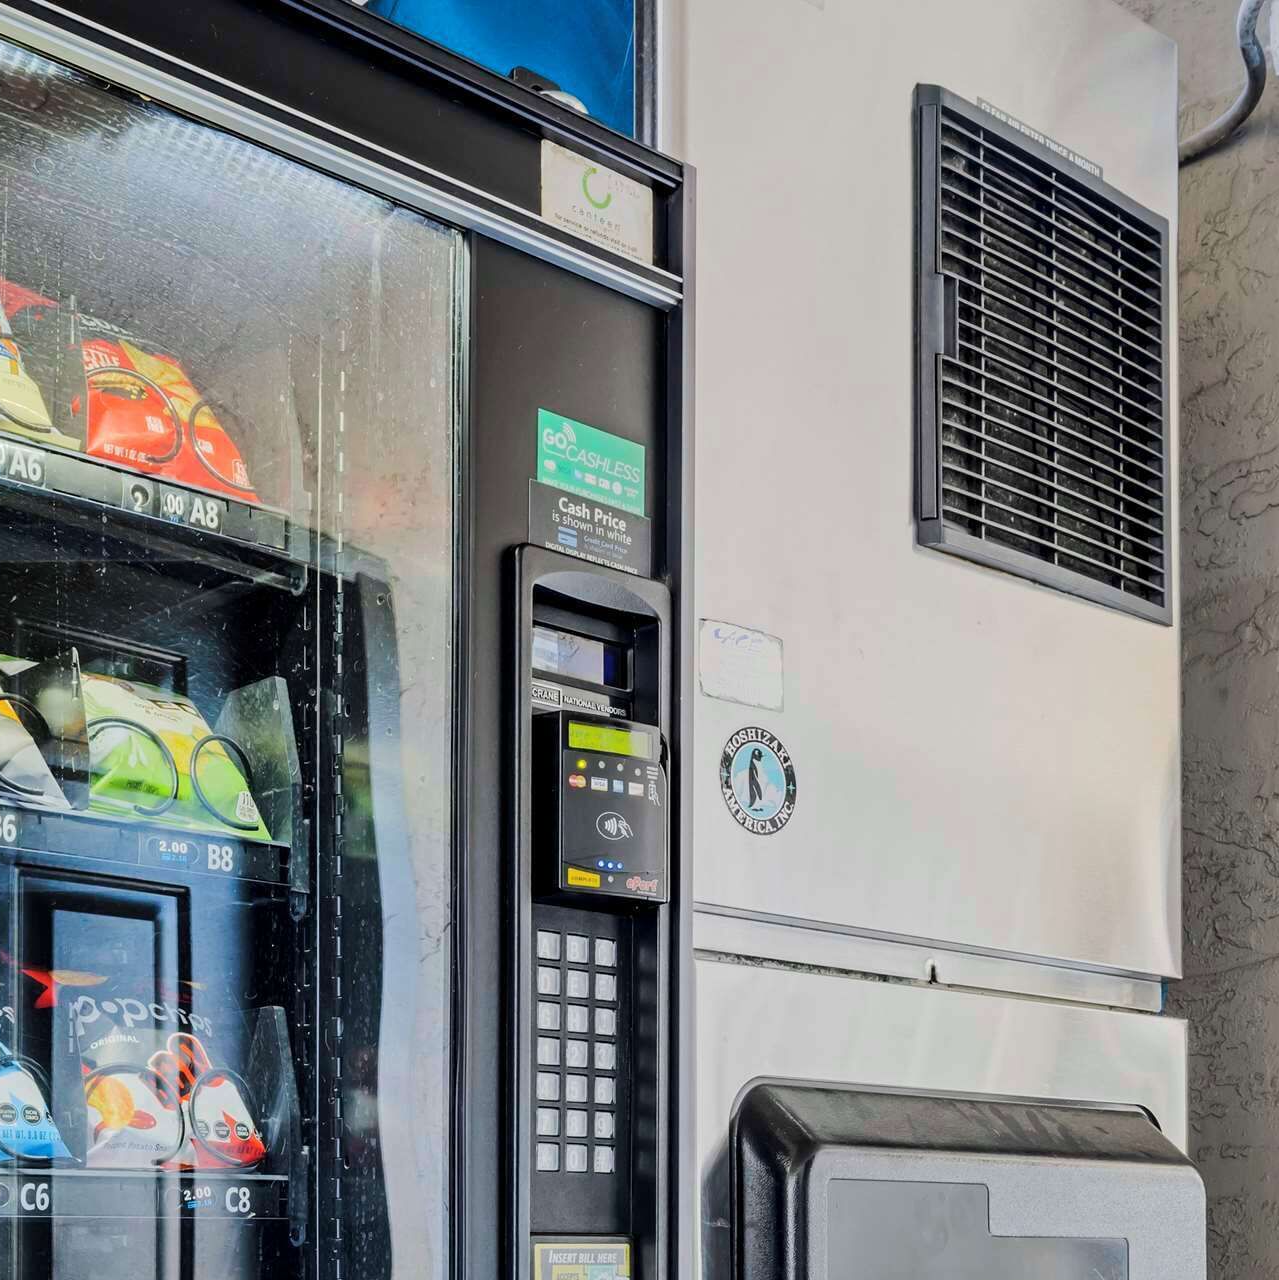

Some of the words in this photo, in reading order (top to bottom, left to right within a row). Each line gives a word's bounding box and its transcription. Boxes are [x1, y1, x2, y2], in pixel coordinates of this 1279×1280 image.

[544, 428, 568, 449] GO
[9, 453, 42, 481] A6
[566, 445, 640, 483] CASHLESS
[191, 502, 219, 528] A8
[552, 509, 559, 522] is
[563, 515, 593, 532] shown
[596, 524, 604, 537] in
[607, 529, 632, 545] white
[559, 497, 590, 520] Cash
[594, 508, 627, 531] Price
[532, 688, 559, 701] CRANE
[563, 696, 596, 710] NATIONAL
[597, 703, 627, 716] VENDORS
[725, 728, 792, 768] HOSHIZAKI
[208, 844, 233, 871] B8
[91, 1034, 139, 1049] ORIGINAL
[22, 1183, 49, 1211] C6
[225, 1187, 250, 1213] C8
[549, 1250, 577, 1264] INSERT
[579, 1253, 596, 1263] BILL
[597, 1253, 617, 1263] HERE
